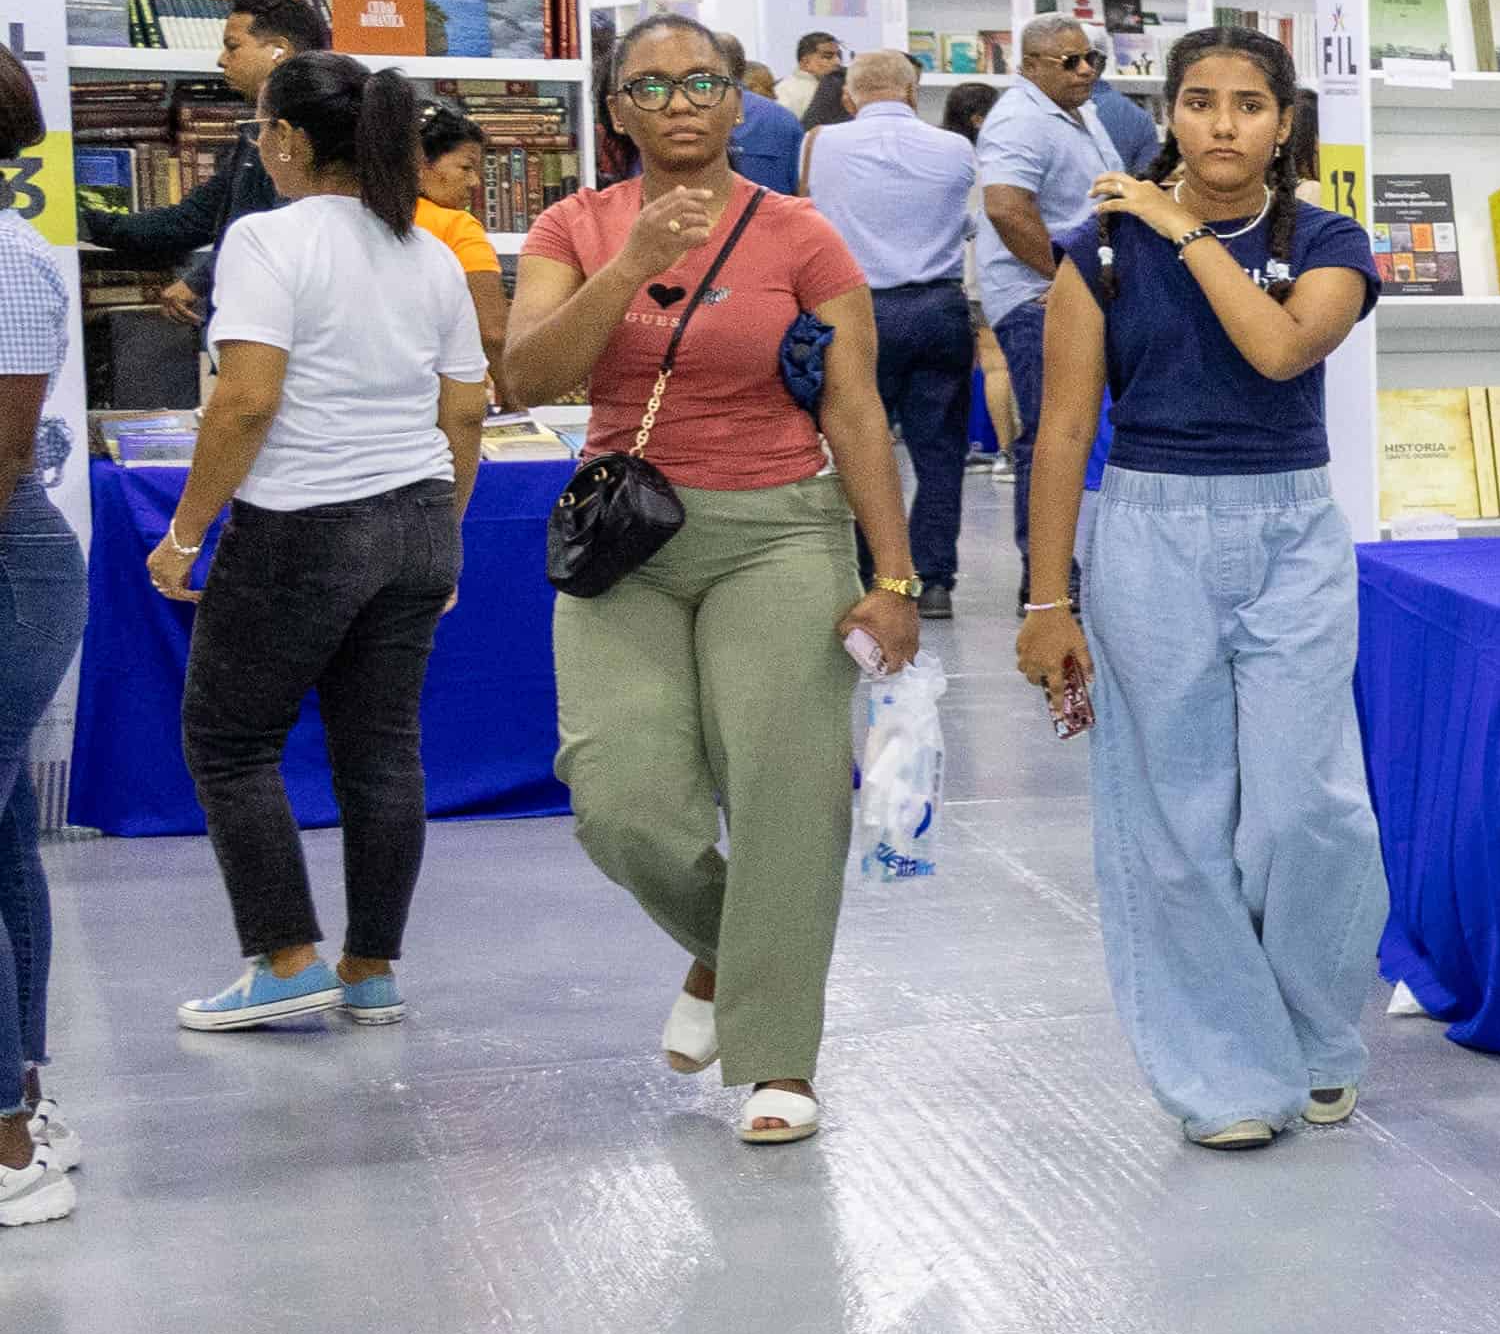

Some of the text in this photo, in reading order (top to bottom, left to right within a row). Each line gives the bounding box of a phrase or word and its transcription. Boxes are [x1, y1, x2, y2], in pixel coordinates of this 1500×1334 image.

[1323, 34, 1357, 76] FIL
[1329, 170, 1358, 218] 13
[624, 312, 681, 327] GUES
[1384, 442, 1446, 454] HISTORIA
